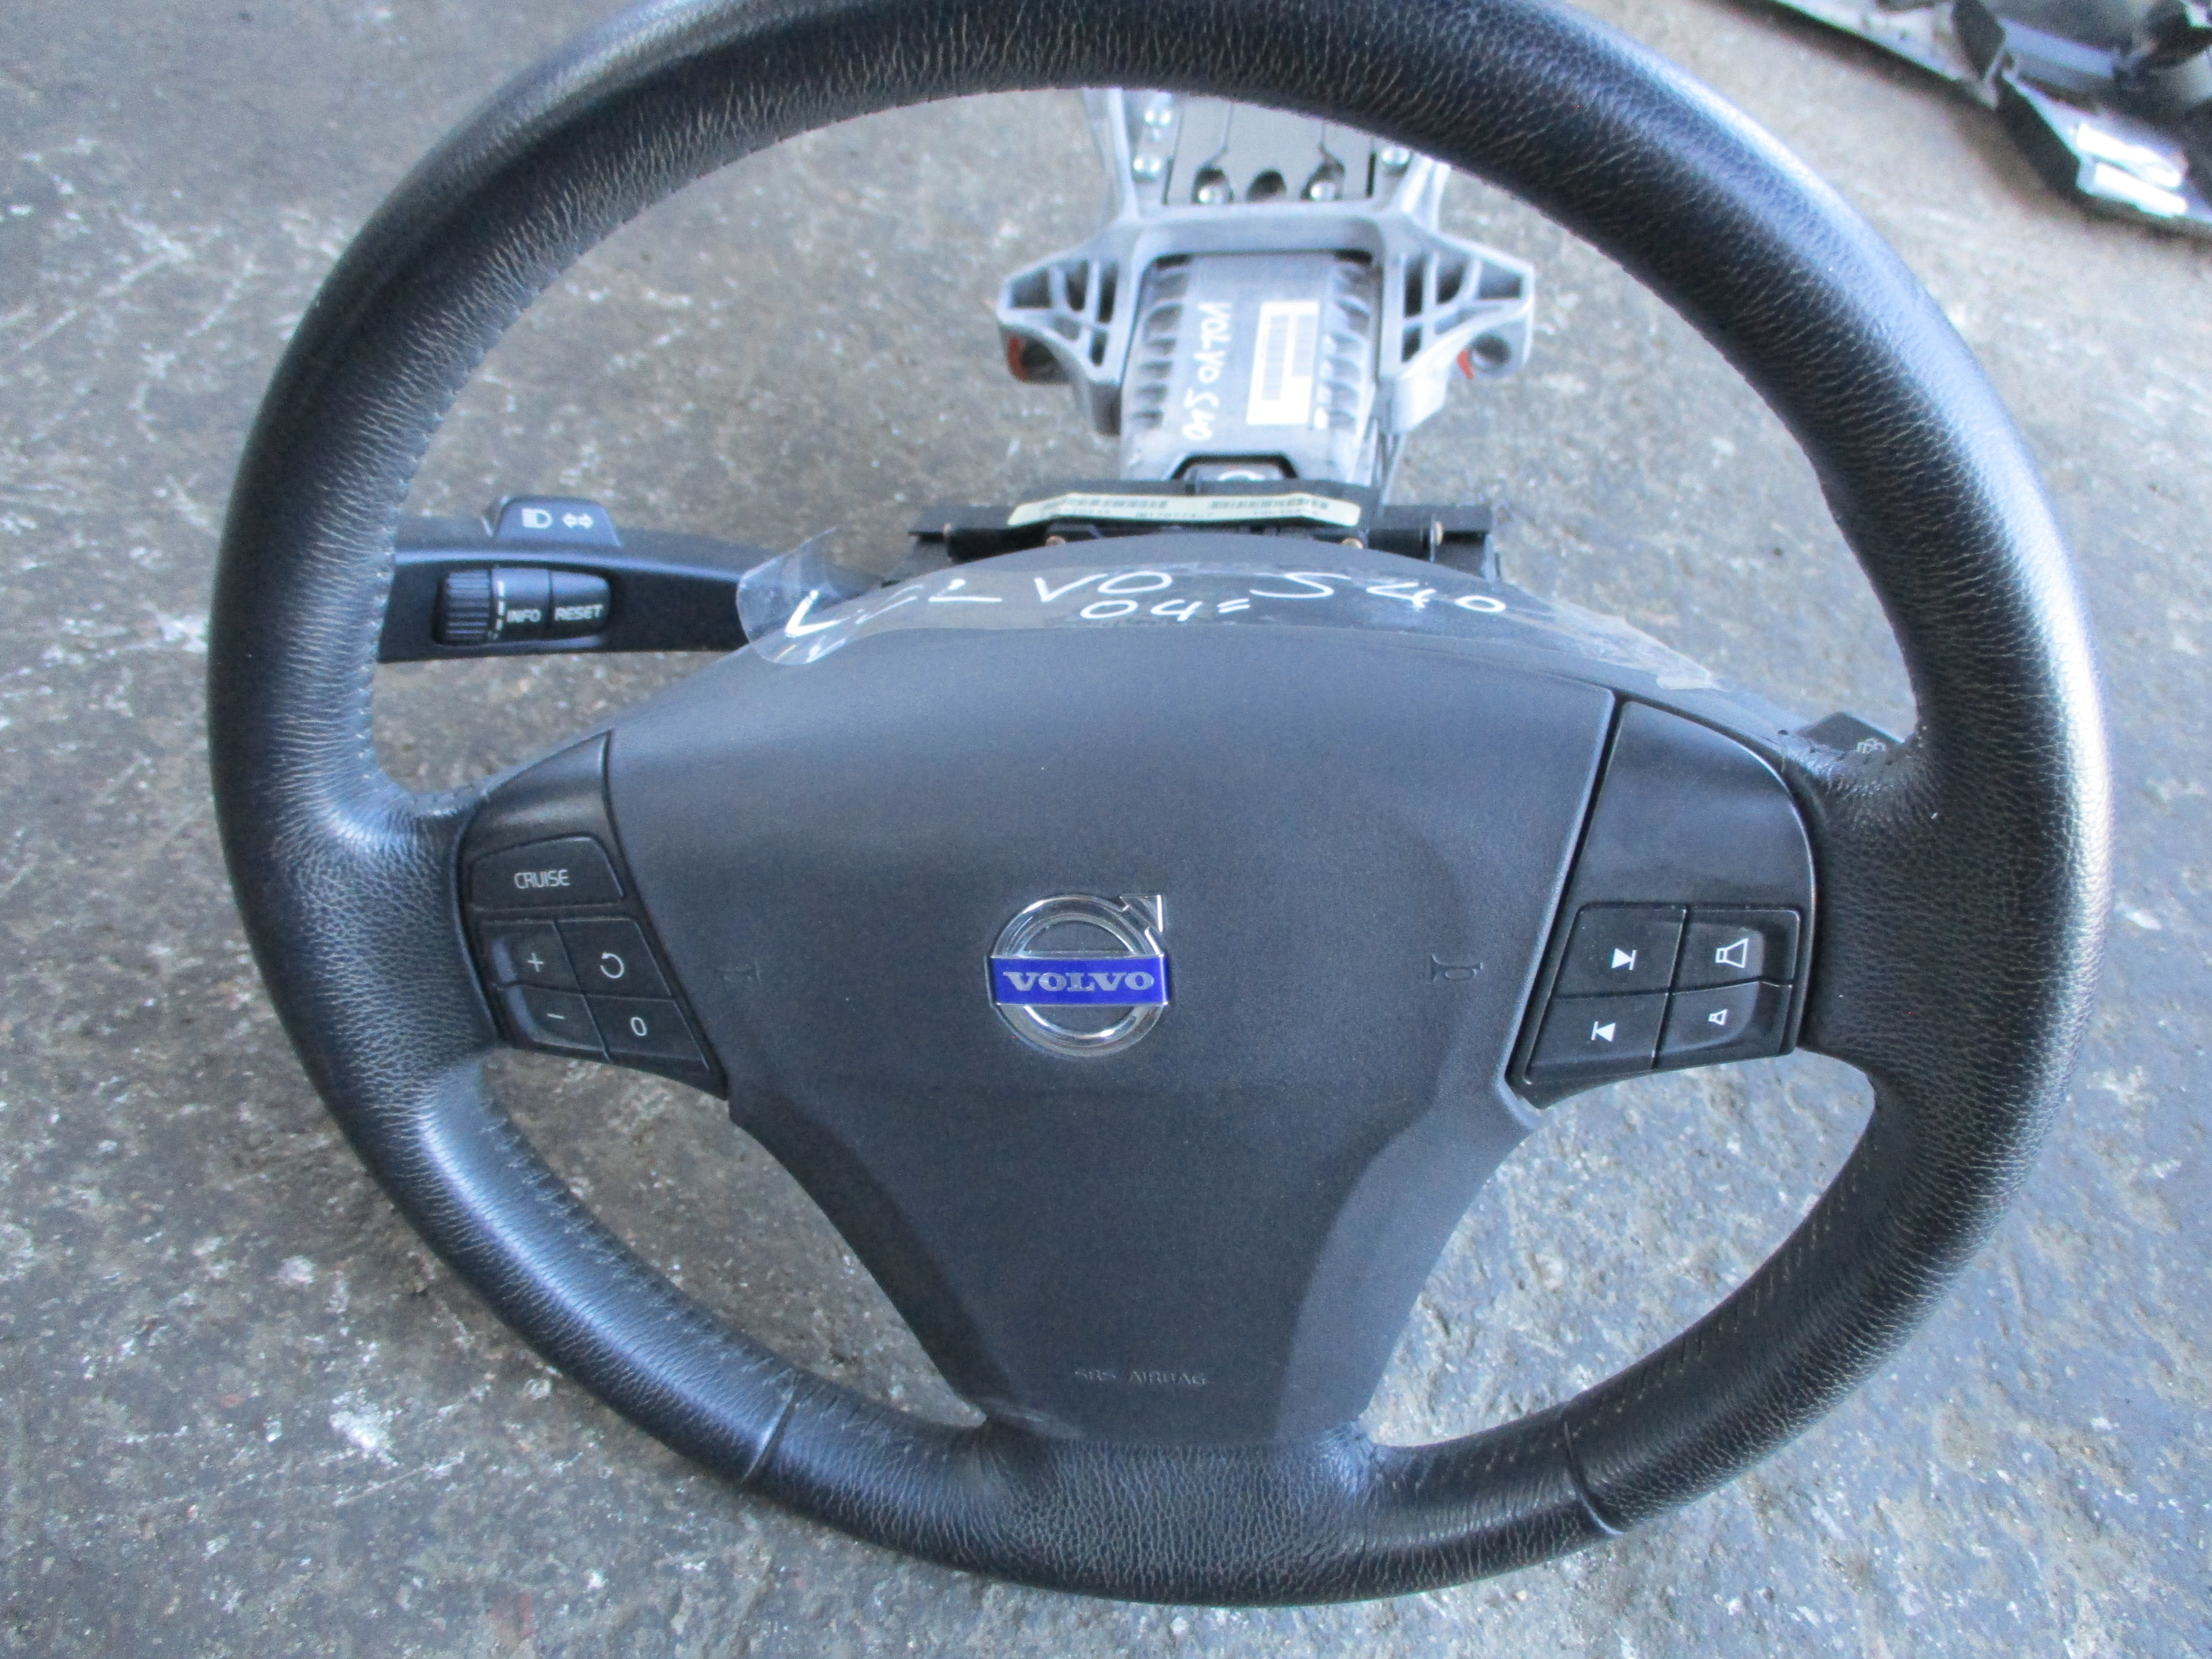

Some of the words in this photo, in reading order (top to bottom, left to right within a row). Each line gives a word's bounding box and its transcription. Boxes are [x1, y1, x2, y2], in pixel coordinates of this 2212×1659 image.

[1193, 302, 1231, 384] VOLVO
[1182, 388, 1220, 441] S40
[1249, 571, 1506, 613] S40
[506, 609, 541, 623] INFO
[555, 605, 603, 621] RESET
[514, 869, 571, 889] CRUISE
[1003, 971, 1155, 992] VOLVO
[1129, 1370, 1207, 1386] AIRBAG
